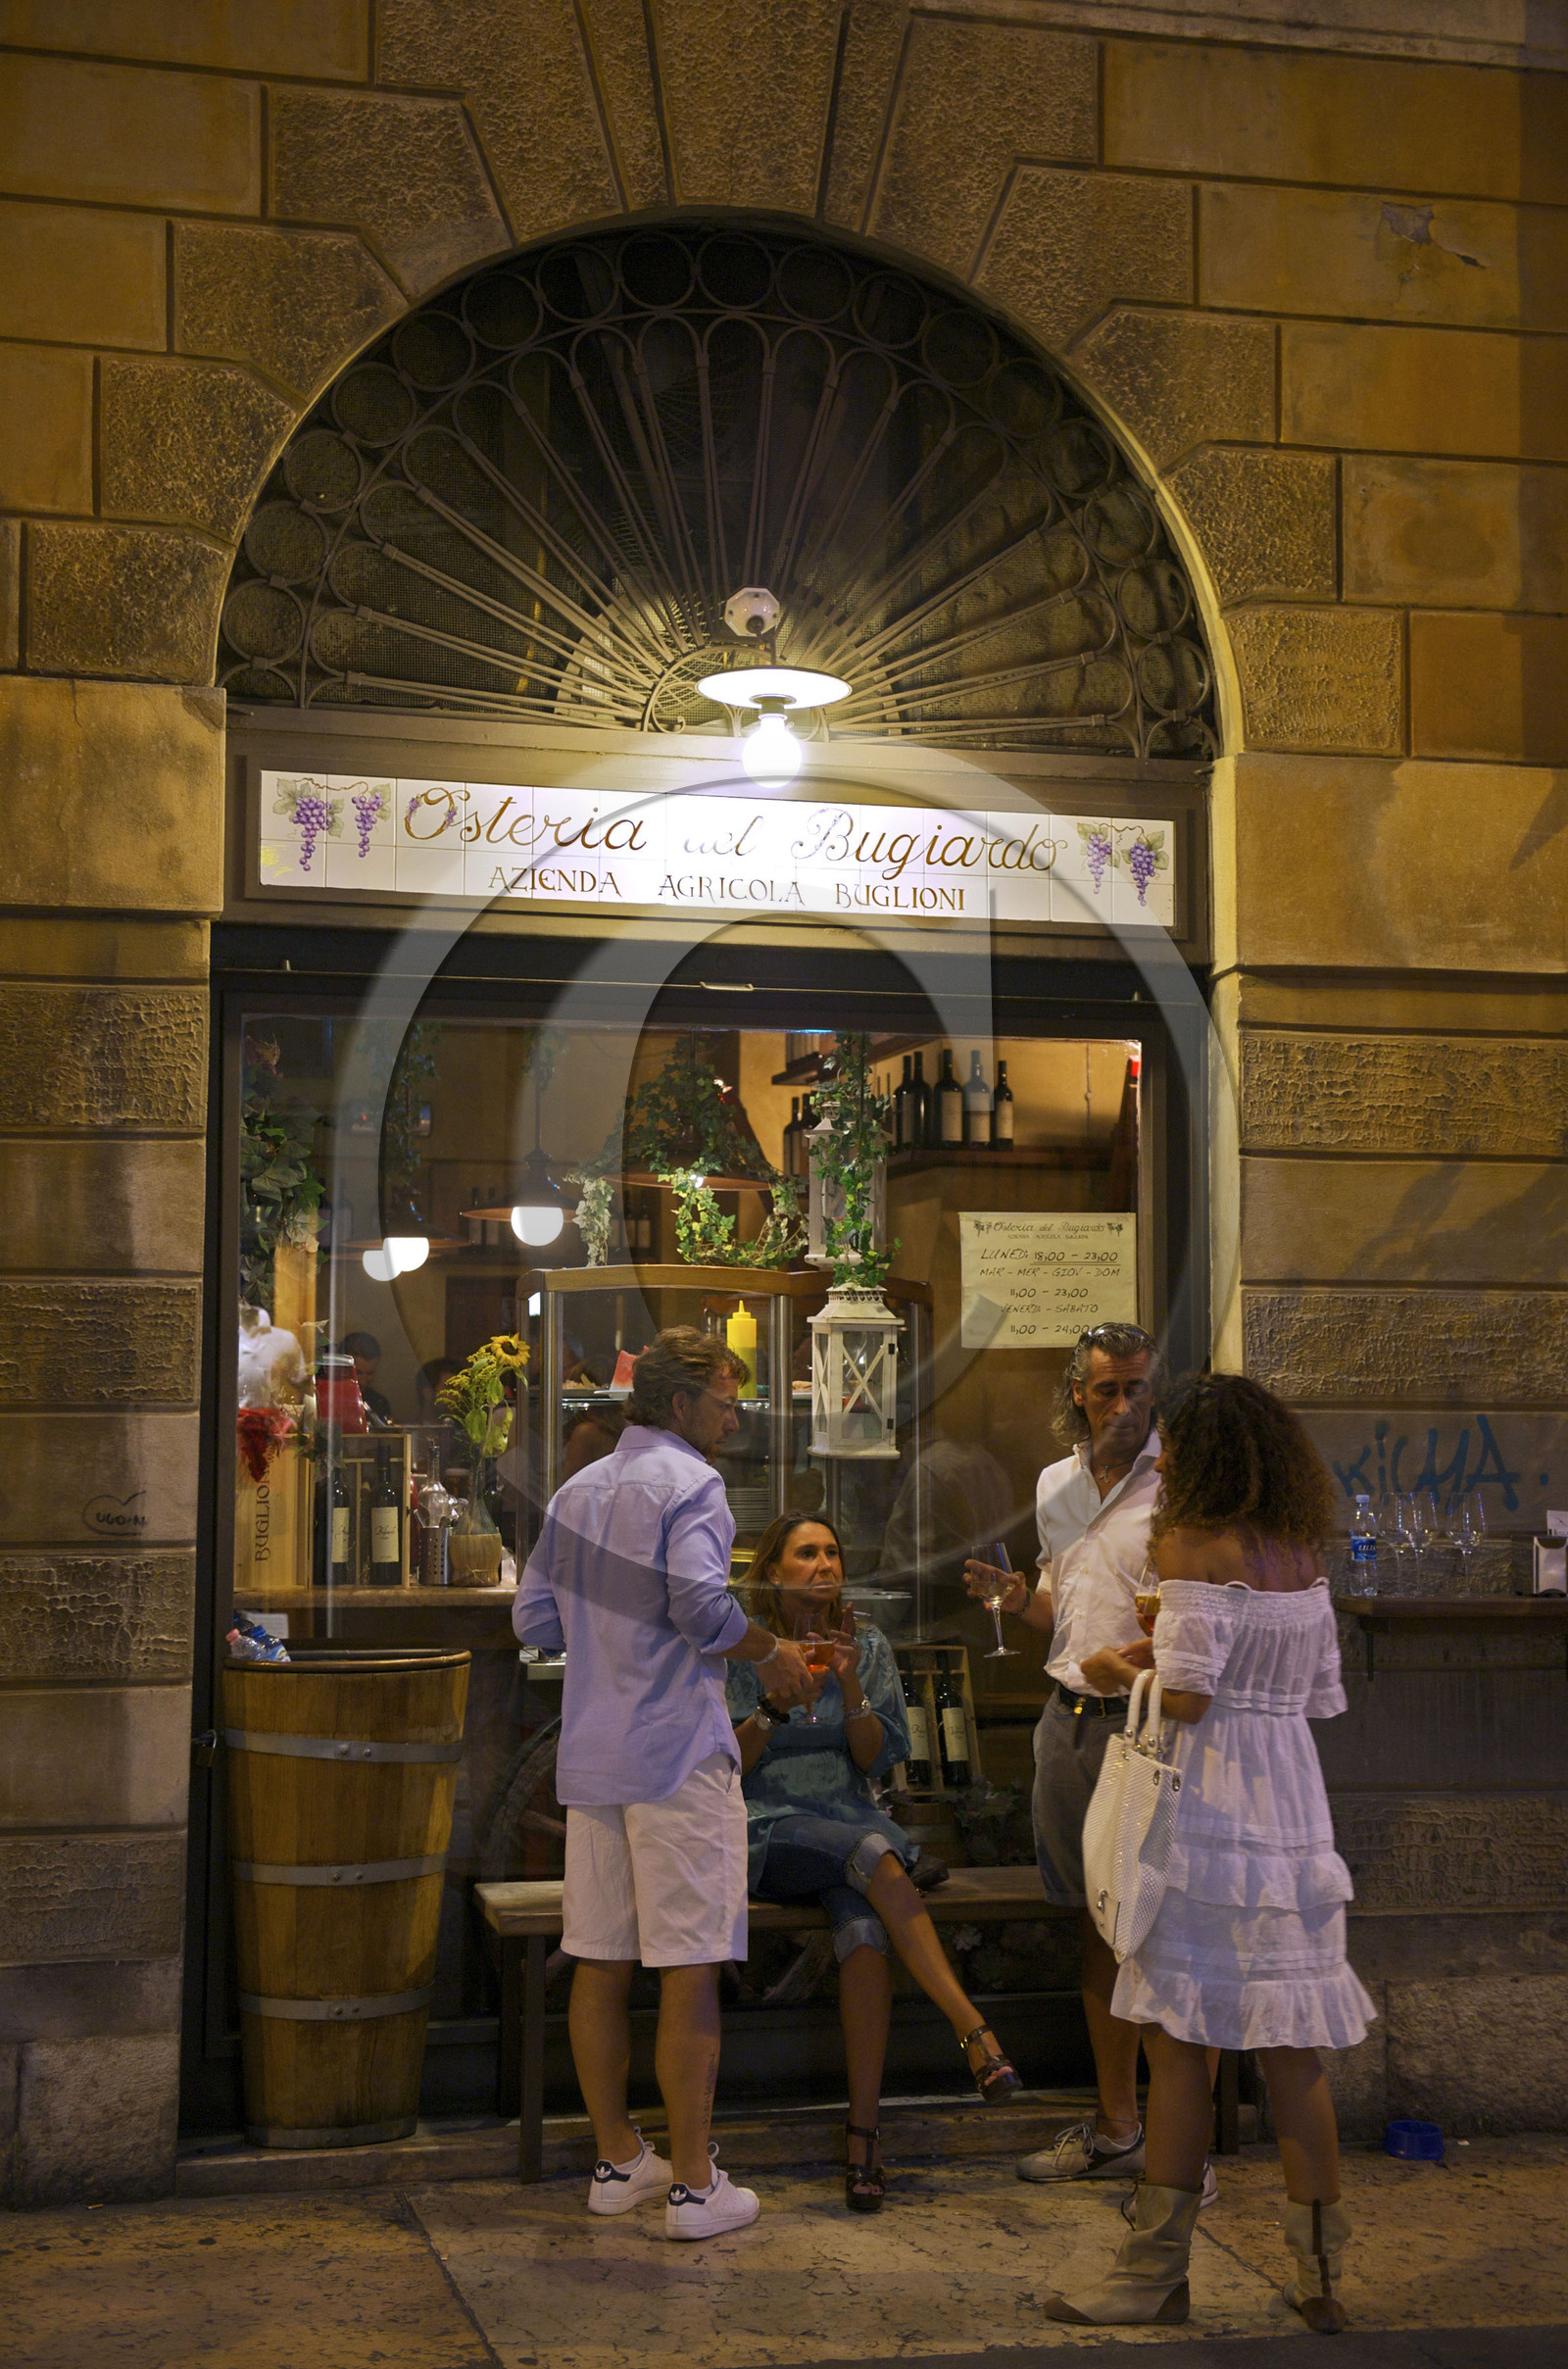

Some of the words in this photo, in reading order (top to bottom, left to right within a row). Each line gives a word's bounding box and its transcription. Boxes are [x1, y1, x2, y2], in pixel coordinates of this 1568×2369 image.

[404, 786, 647, 851] Osteria
[790, 807, 1068, 881] Bugiardo
[488, 865, 622, 897] AZIENDA
[659, 872, 806, 907] AGRICOLA
[835, 881, 966, 912] BUGLIONI
[1083, 1252, 1118, 1262] 23,00
[980, 1266, 1005, 1277] MAR
[1017, 1266, 1041, 1277] MER
[1093, 1267, 1121, 1277] DOM
[1054, 1288, 1089, 1298] 23,00
[1054, 1304, 1099, 1313] SABATO
